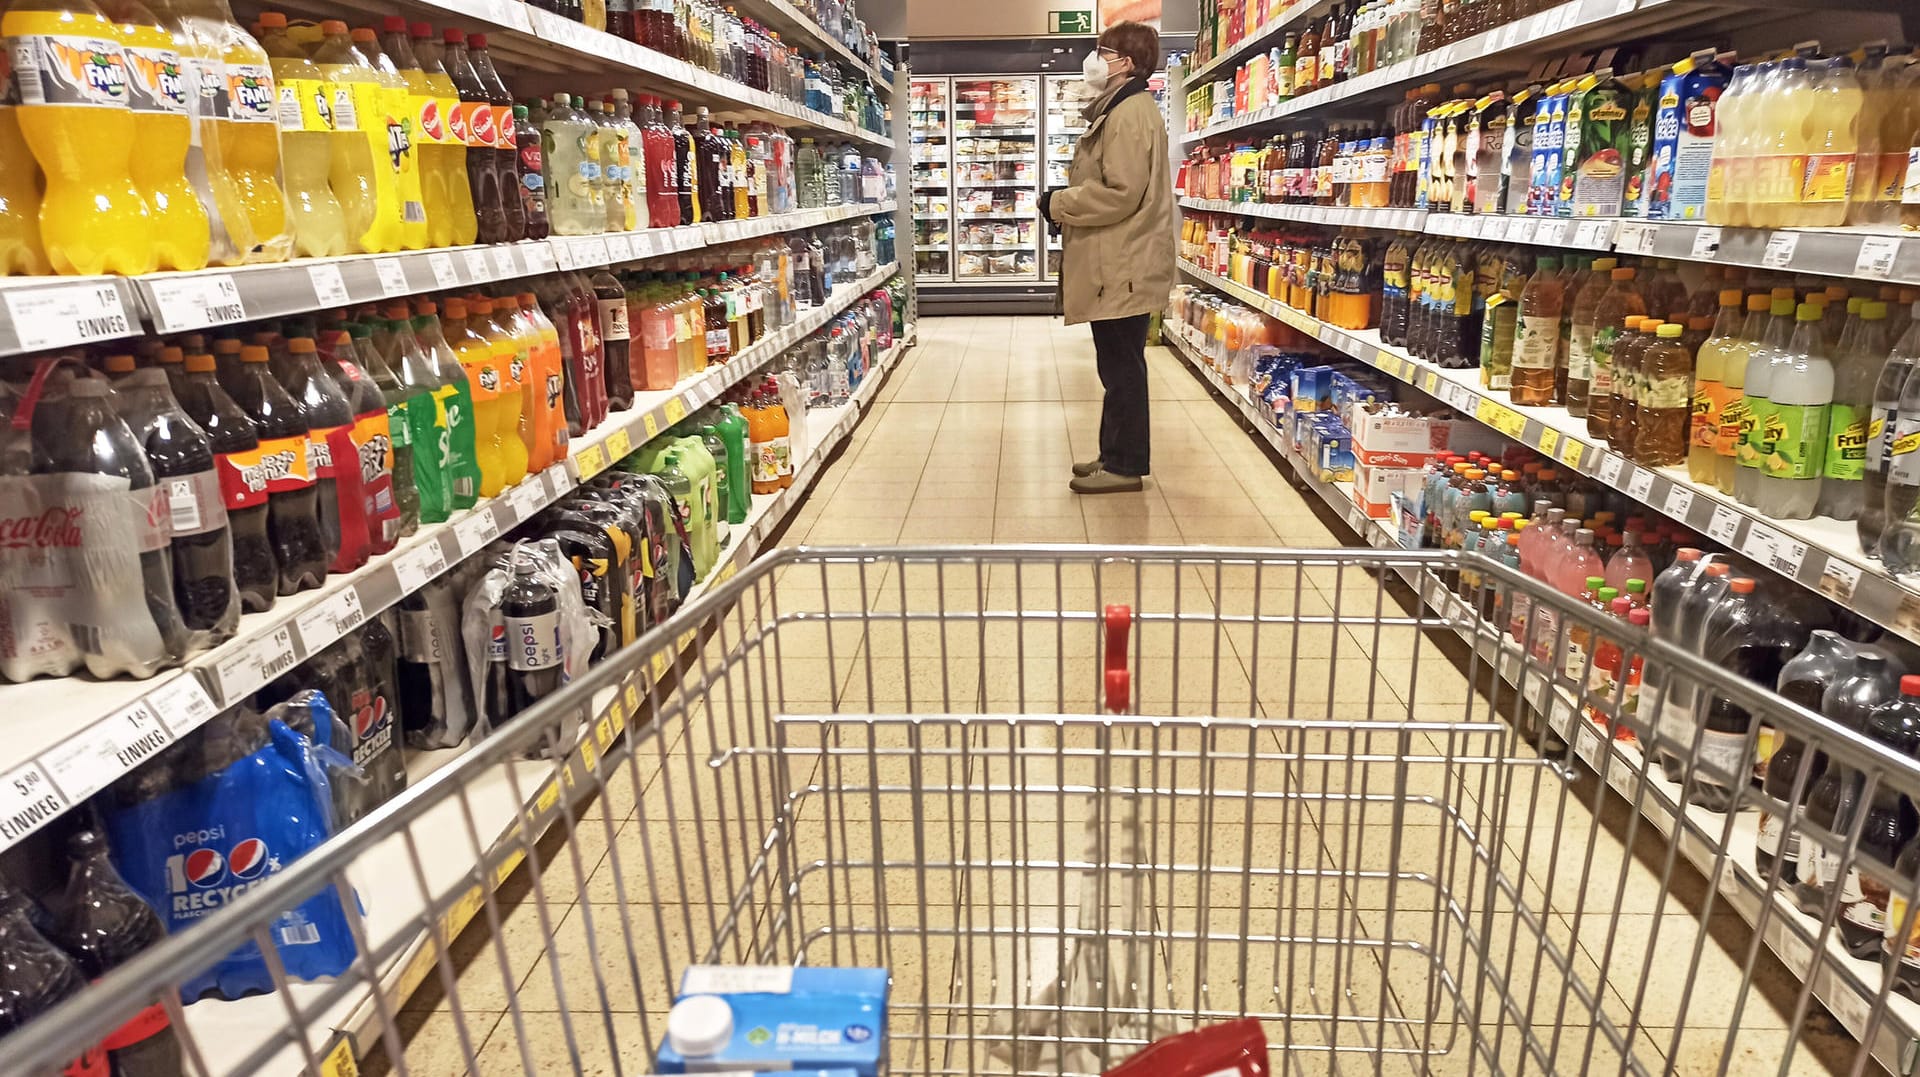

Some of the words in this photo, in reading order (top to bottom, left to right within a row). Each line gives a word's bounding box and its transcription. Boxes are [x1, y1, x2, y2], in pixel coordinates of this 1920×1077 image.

[76, 314, 126, 338] EINWEG
[206, 303, 244, 324] EINWEG
[520, 622, 542, 667] pepsi
[261, 649, 294, 680] EINWEG
[116, 729, 166, 767] EINWEG
[0, 794, 60, 841] EINWEG
[173, 824, 226, 850] pepsi
